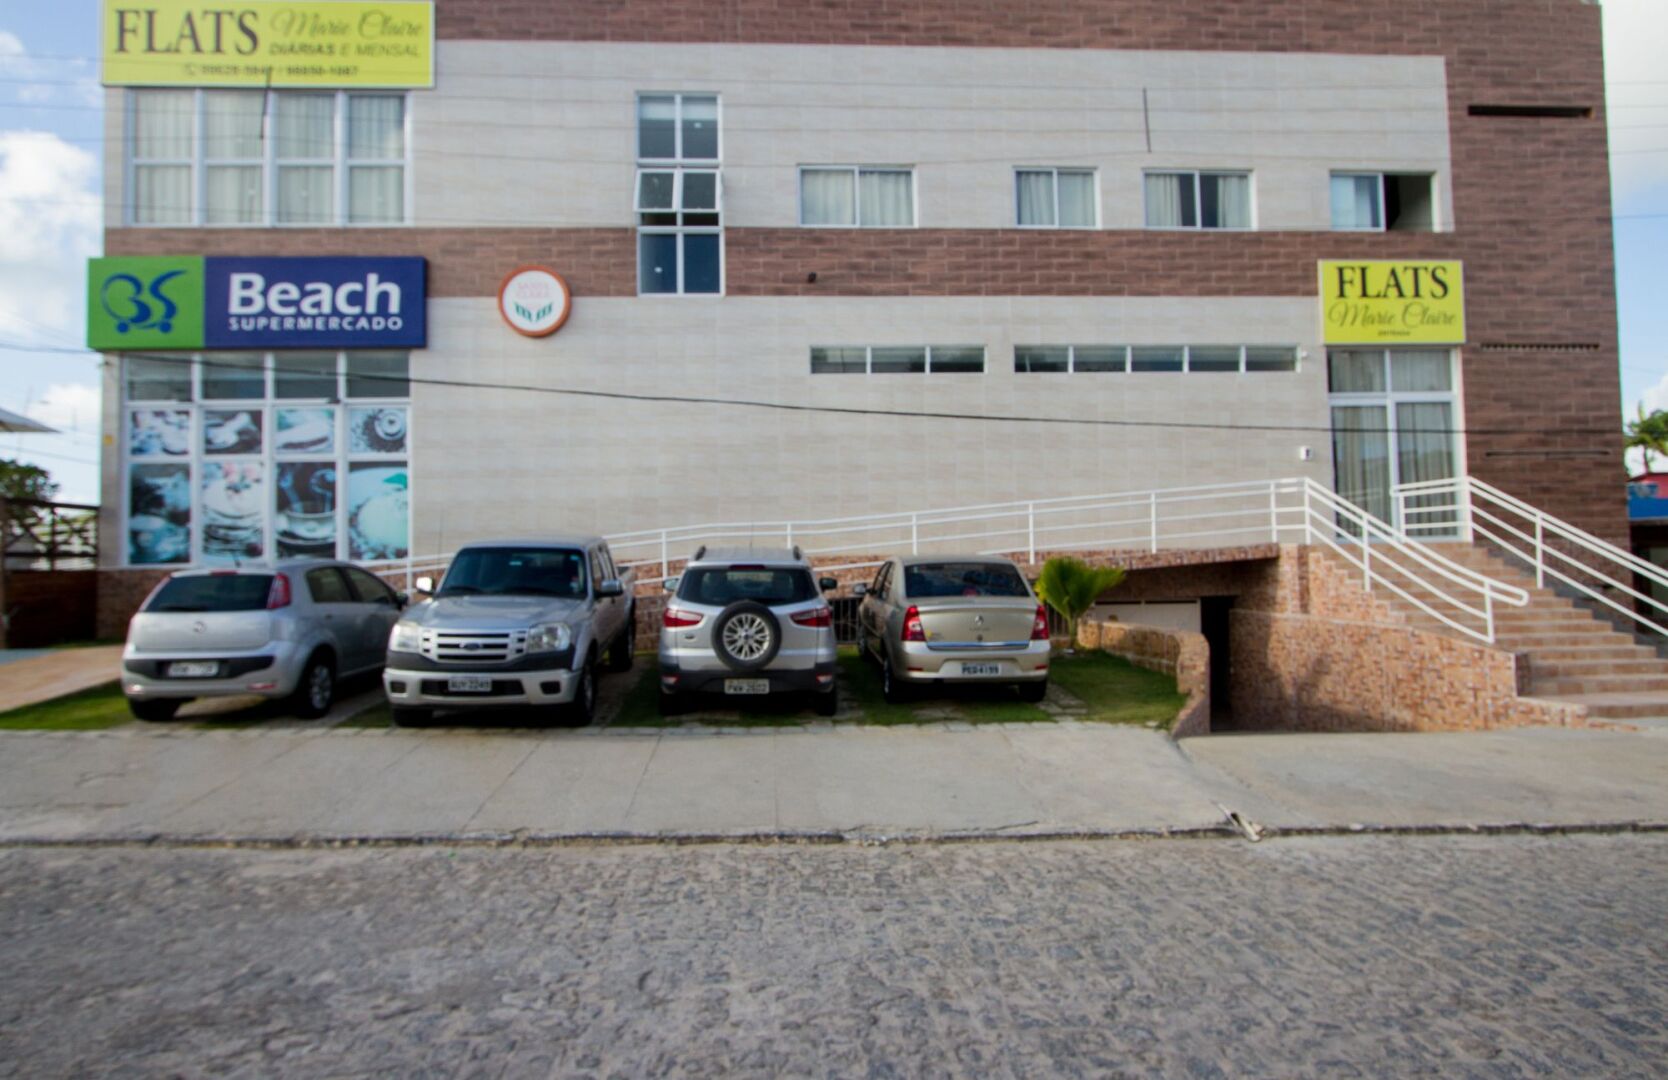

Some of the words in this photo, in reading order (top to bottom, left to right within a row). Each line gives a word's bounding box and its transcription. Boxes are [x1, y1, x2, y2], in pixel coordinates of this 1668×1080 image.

[114, 9, 259, 55] FLATS
[270, 8, 351, 37] Marie
[357, 8, 423, 39] Claire
[228, 273, 401, 315] Beach
[1336, 265, 1449, 299] FLATS
[228, 316, 403, 332] SUPERMERCADO
[1328, 301, 1396, 328] Marie
[1402, 301, 1456, 328] Claire
